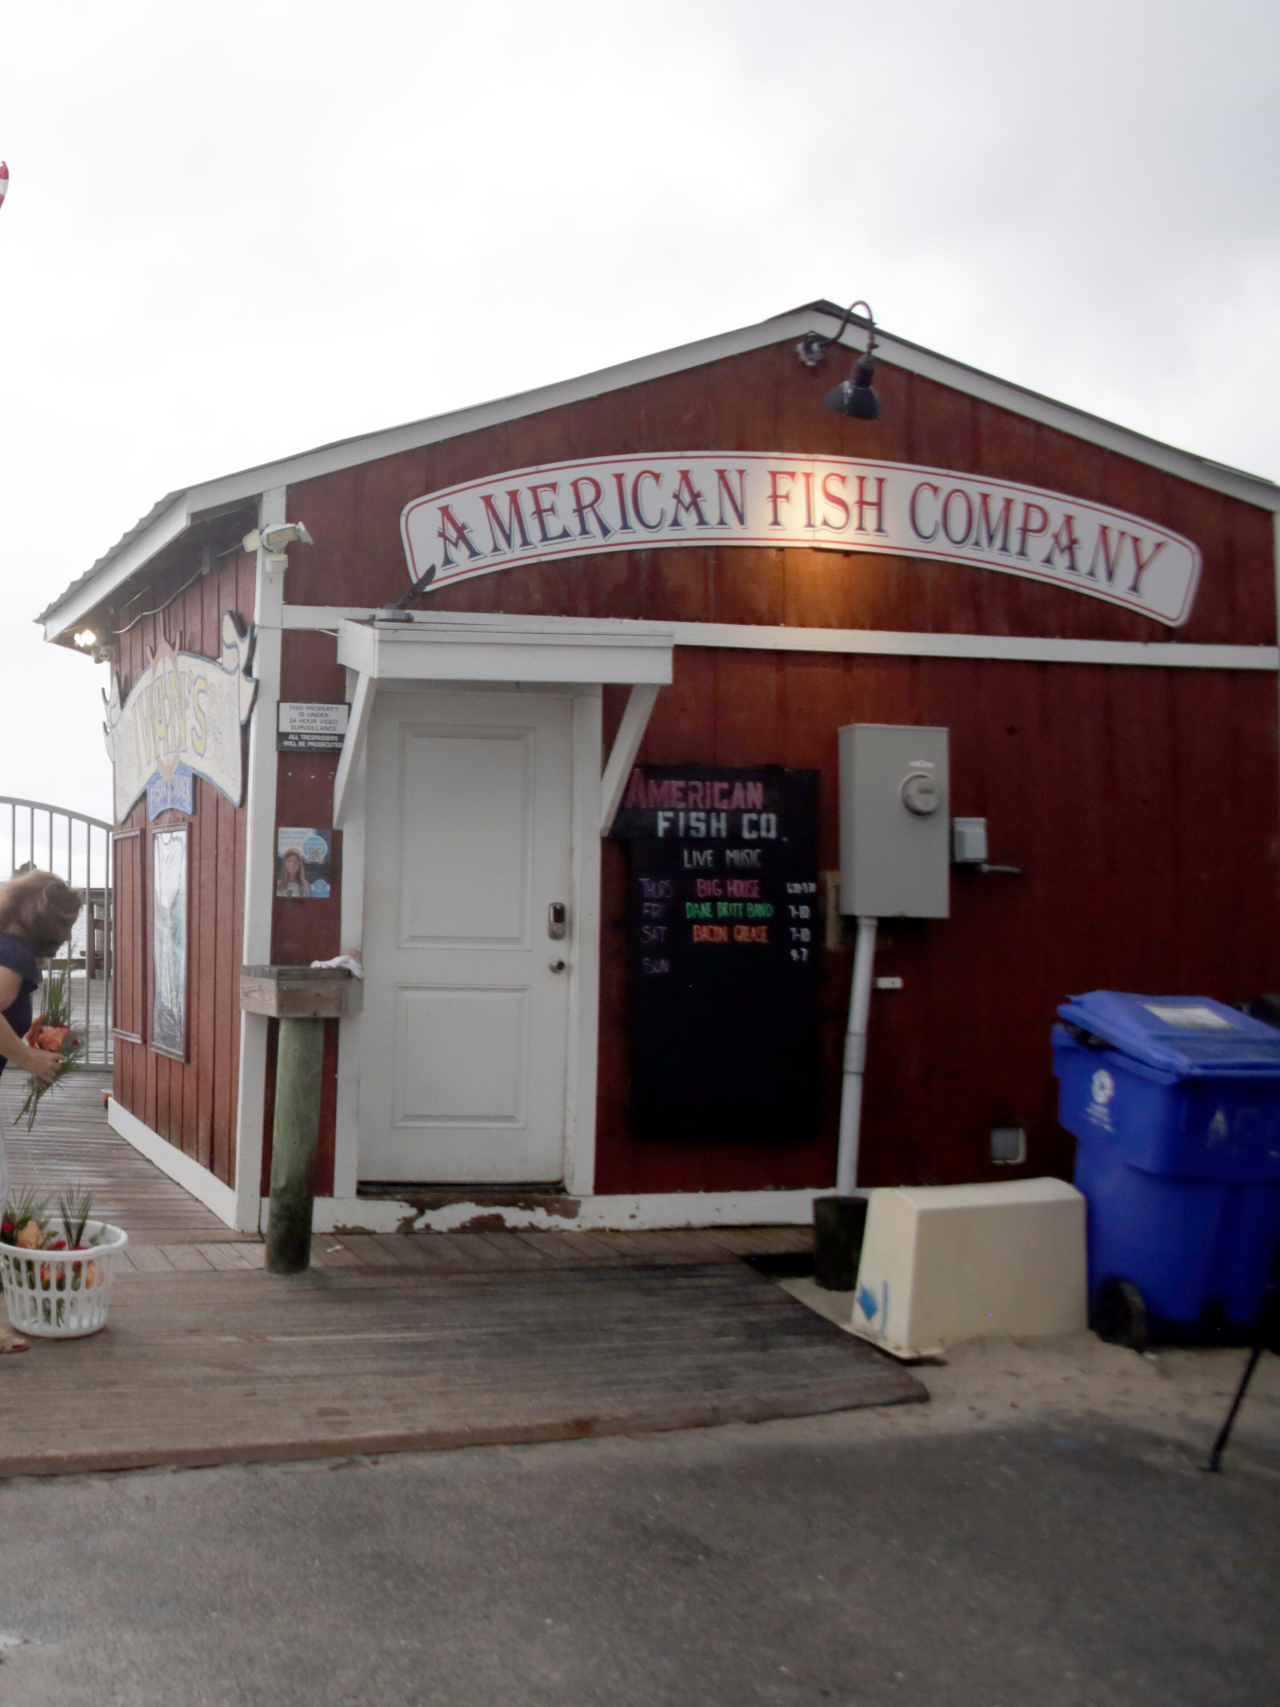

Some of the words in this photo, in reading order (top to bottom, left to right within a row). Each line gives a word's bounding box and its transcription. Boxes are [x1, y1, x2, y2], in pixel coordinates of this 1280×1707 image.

[435, 468, 749, 570] AMERICAN
[767, 470, 889, 534] FISH
[908, 481, 1167, 597] COMPANY
[131, 668, 208, 778] IVAN'S
[625, 769, 766, 810] AMERICAN
[657, 812, 728, 839] FISH
[742, 813, 789, 843] CO.
[684, 850, 714, 869] LIVE
[726, 849, 762, 869] MUSIC
[697, 879, 723, 899] BIG
[727, 879, 762, 899] HOUSE
[685, 902, 714, 920] DANE
[747, 903, 775, 919] BAND
[640, 926, 668, 945] SAT
[642, 958, 673, 975] SUN
